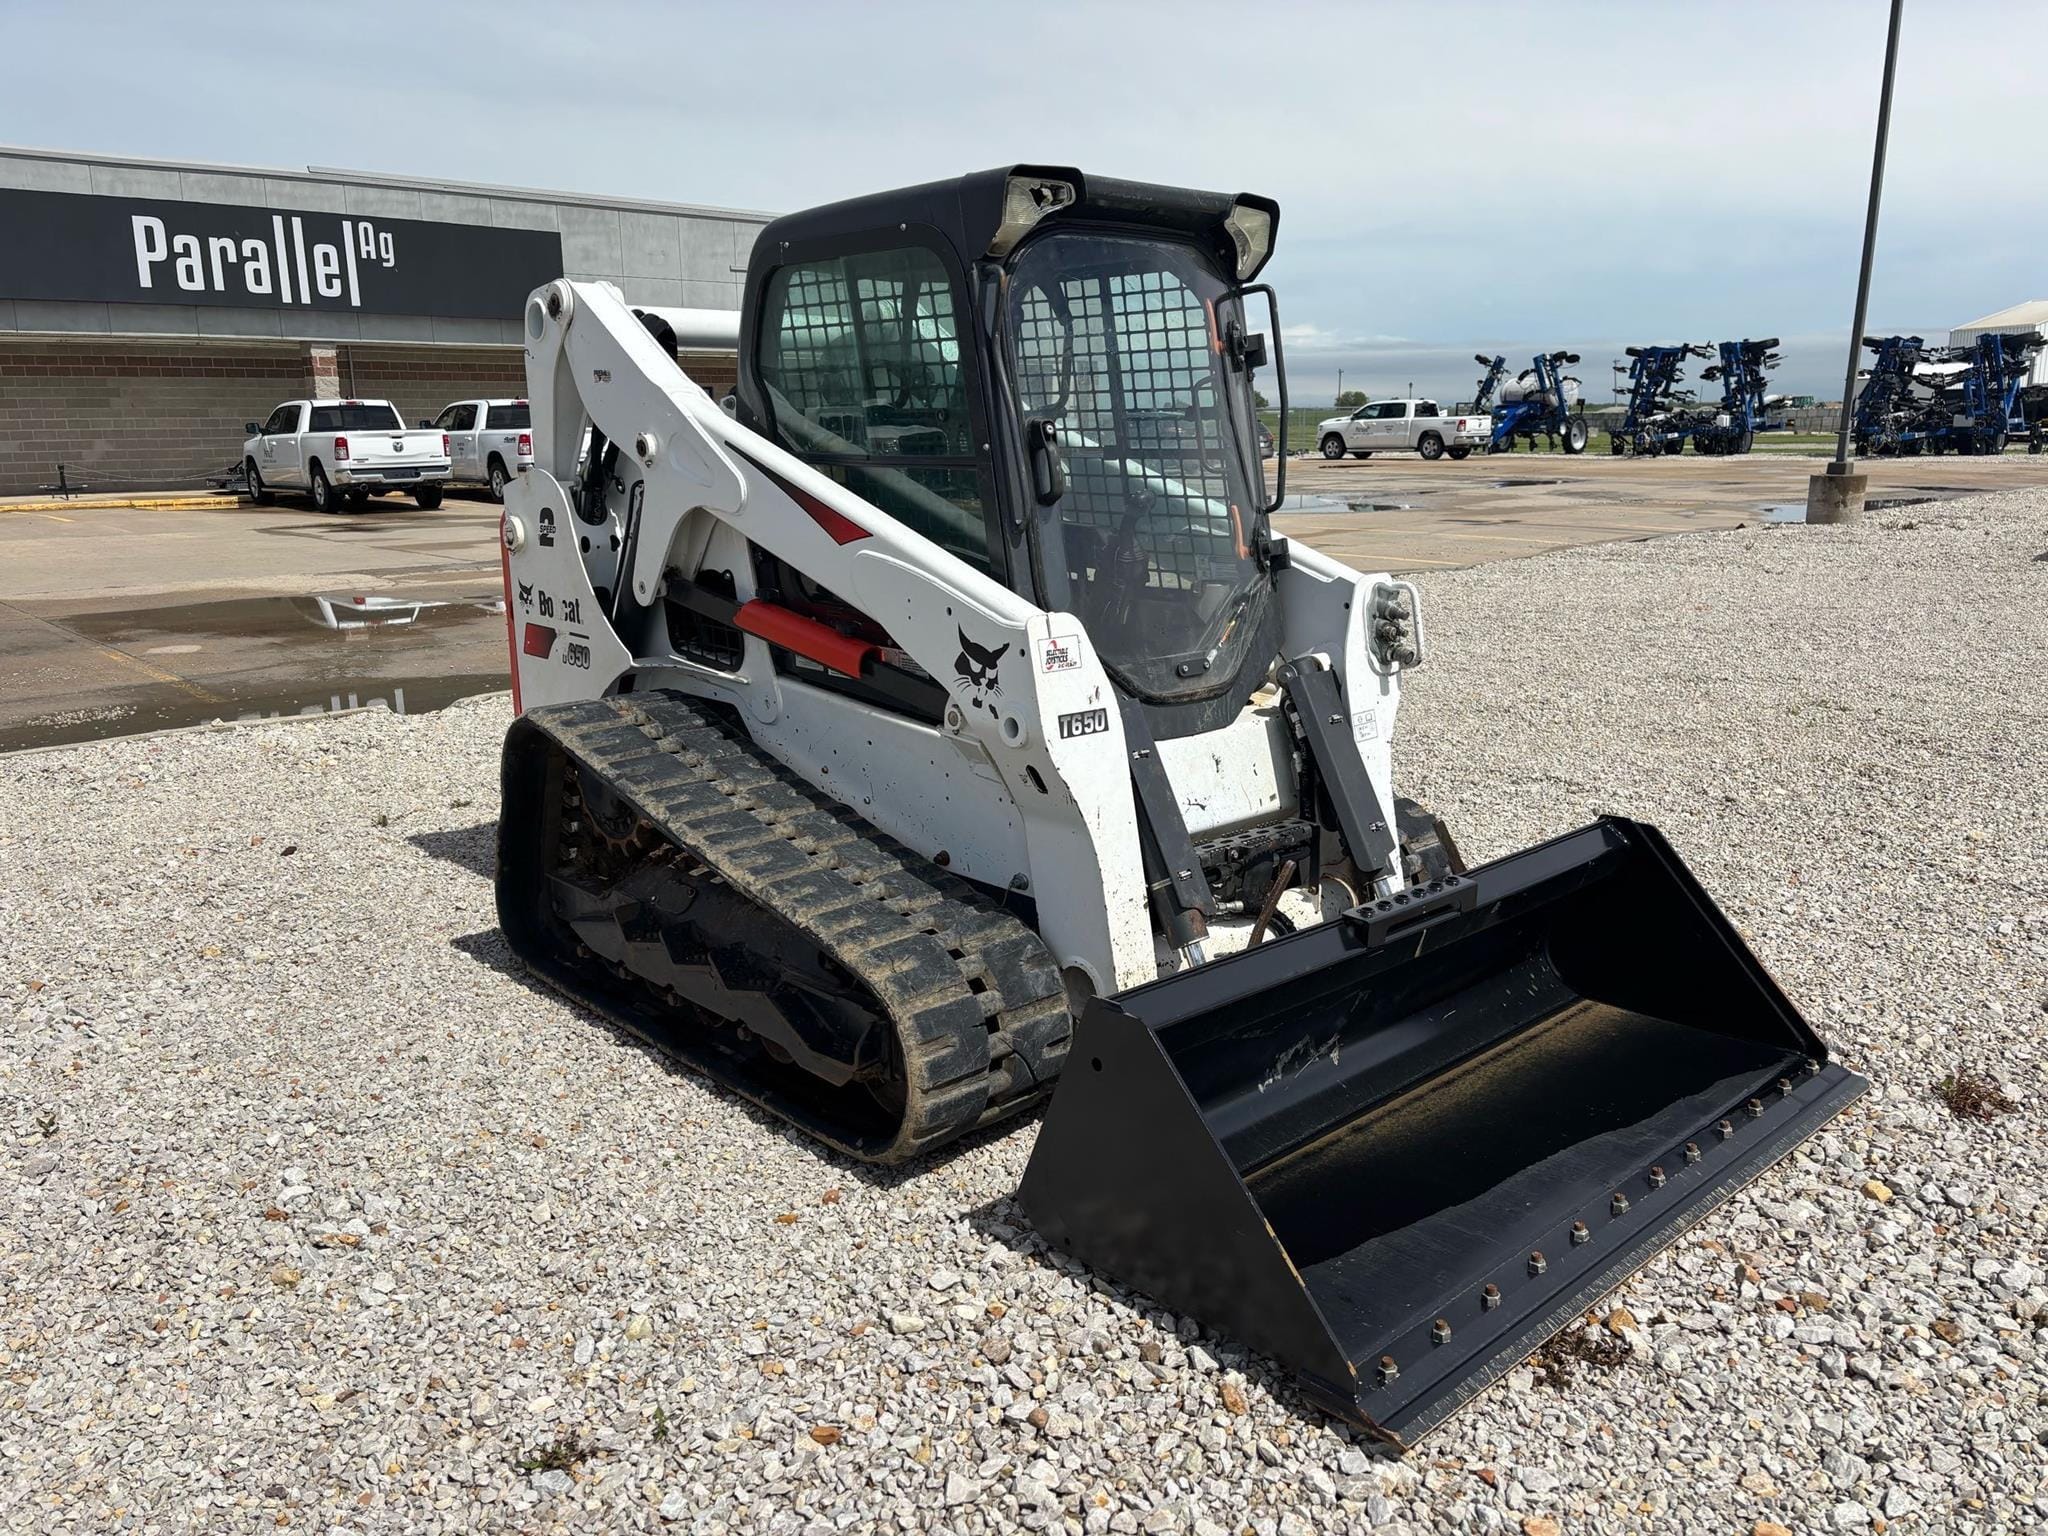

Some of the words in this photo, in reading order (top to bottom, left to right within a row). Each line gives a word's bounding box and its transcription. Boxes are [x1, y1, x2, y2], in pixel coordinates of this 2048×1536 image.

[131, 215, 361, 307] Parallel
[358, 221, 395, 268] Ag
[539, 524, 557, 534] SPEED
[1060, 711, 1106, 738] T650
